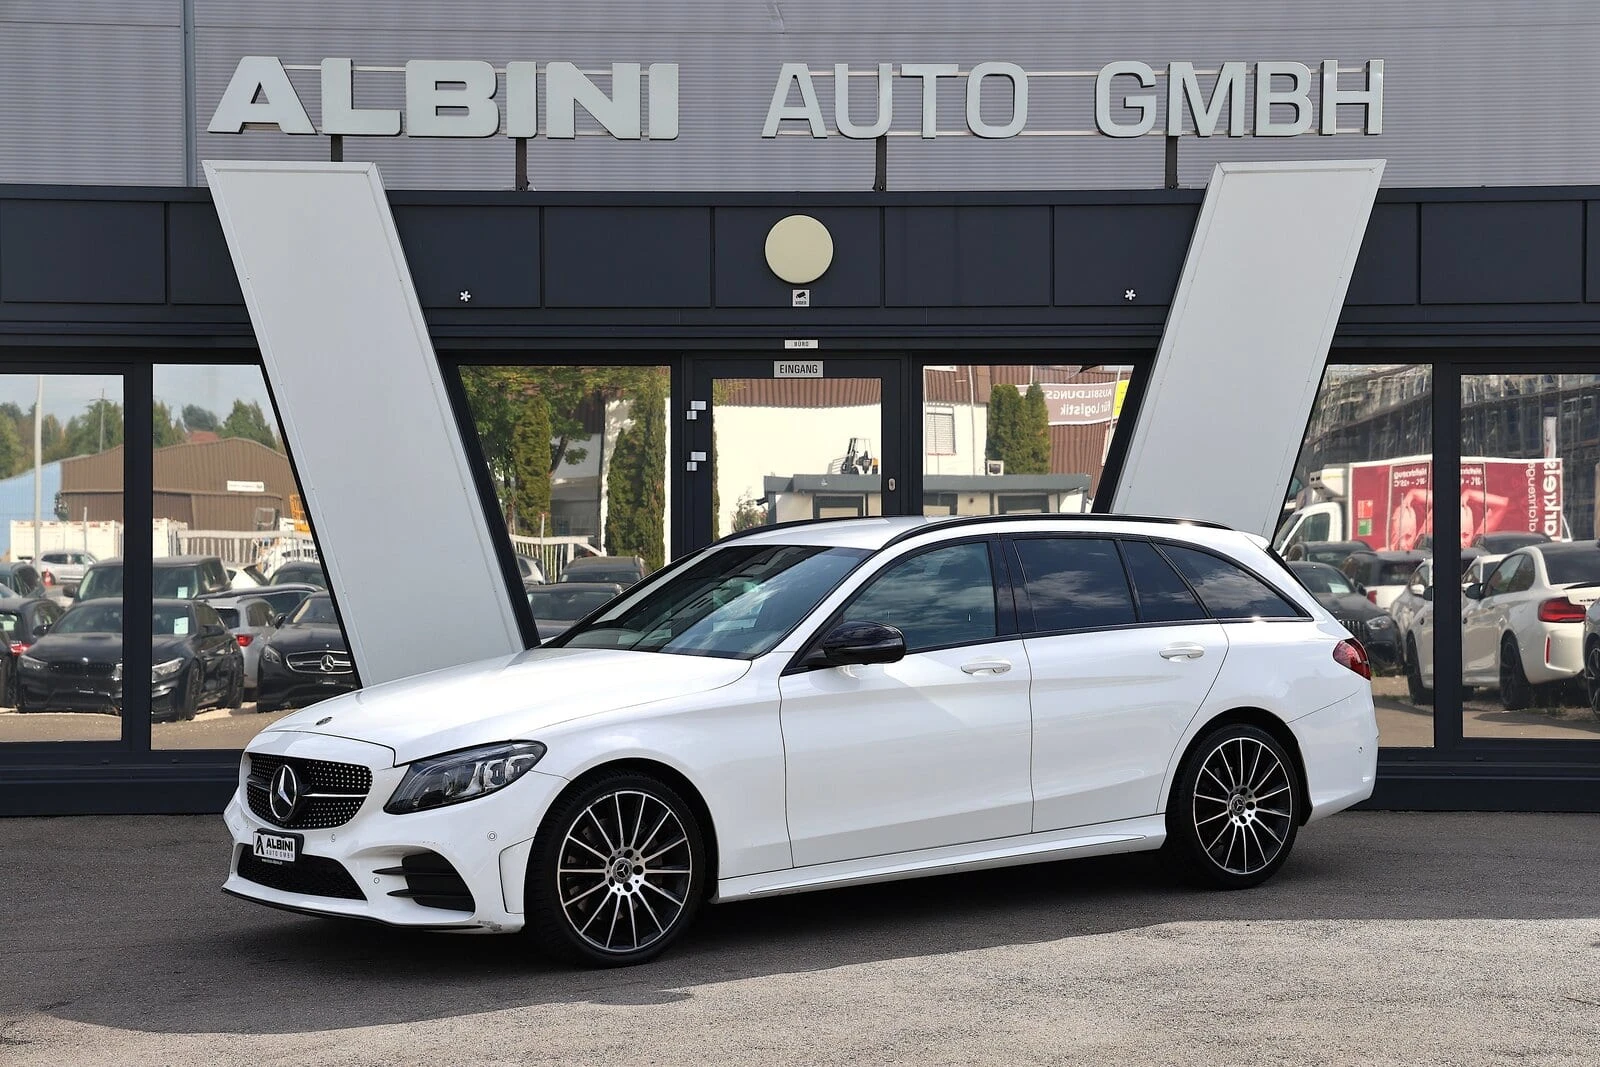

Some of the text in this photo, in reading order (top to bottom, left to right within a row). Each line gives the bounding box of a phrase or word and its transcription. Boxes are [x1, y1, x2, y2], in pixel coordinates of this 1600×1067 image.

[206, 56, 1385, 140] ALBINI AUTO GMBH
[779, 364, 818, 374] EINGANG
[266, 837, 293, 851] ALBINI
